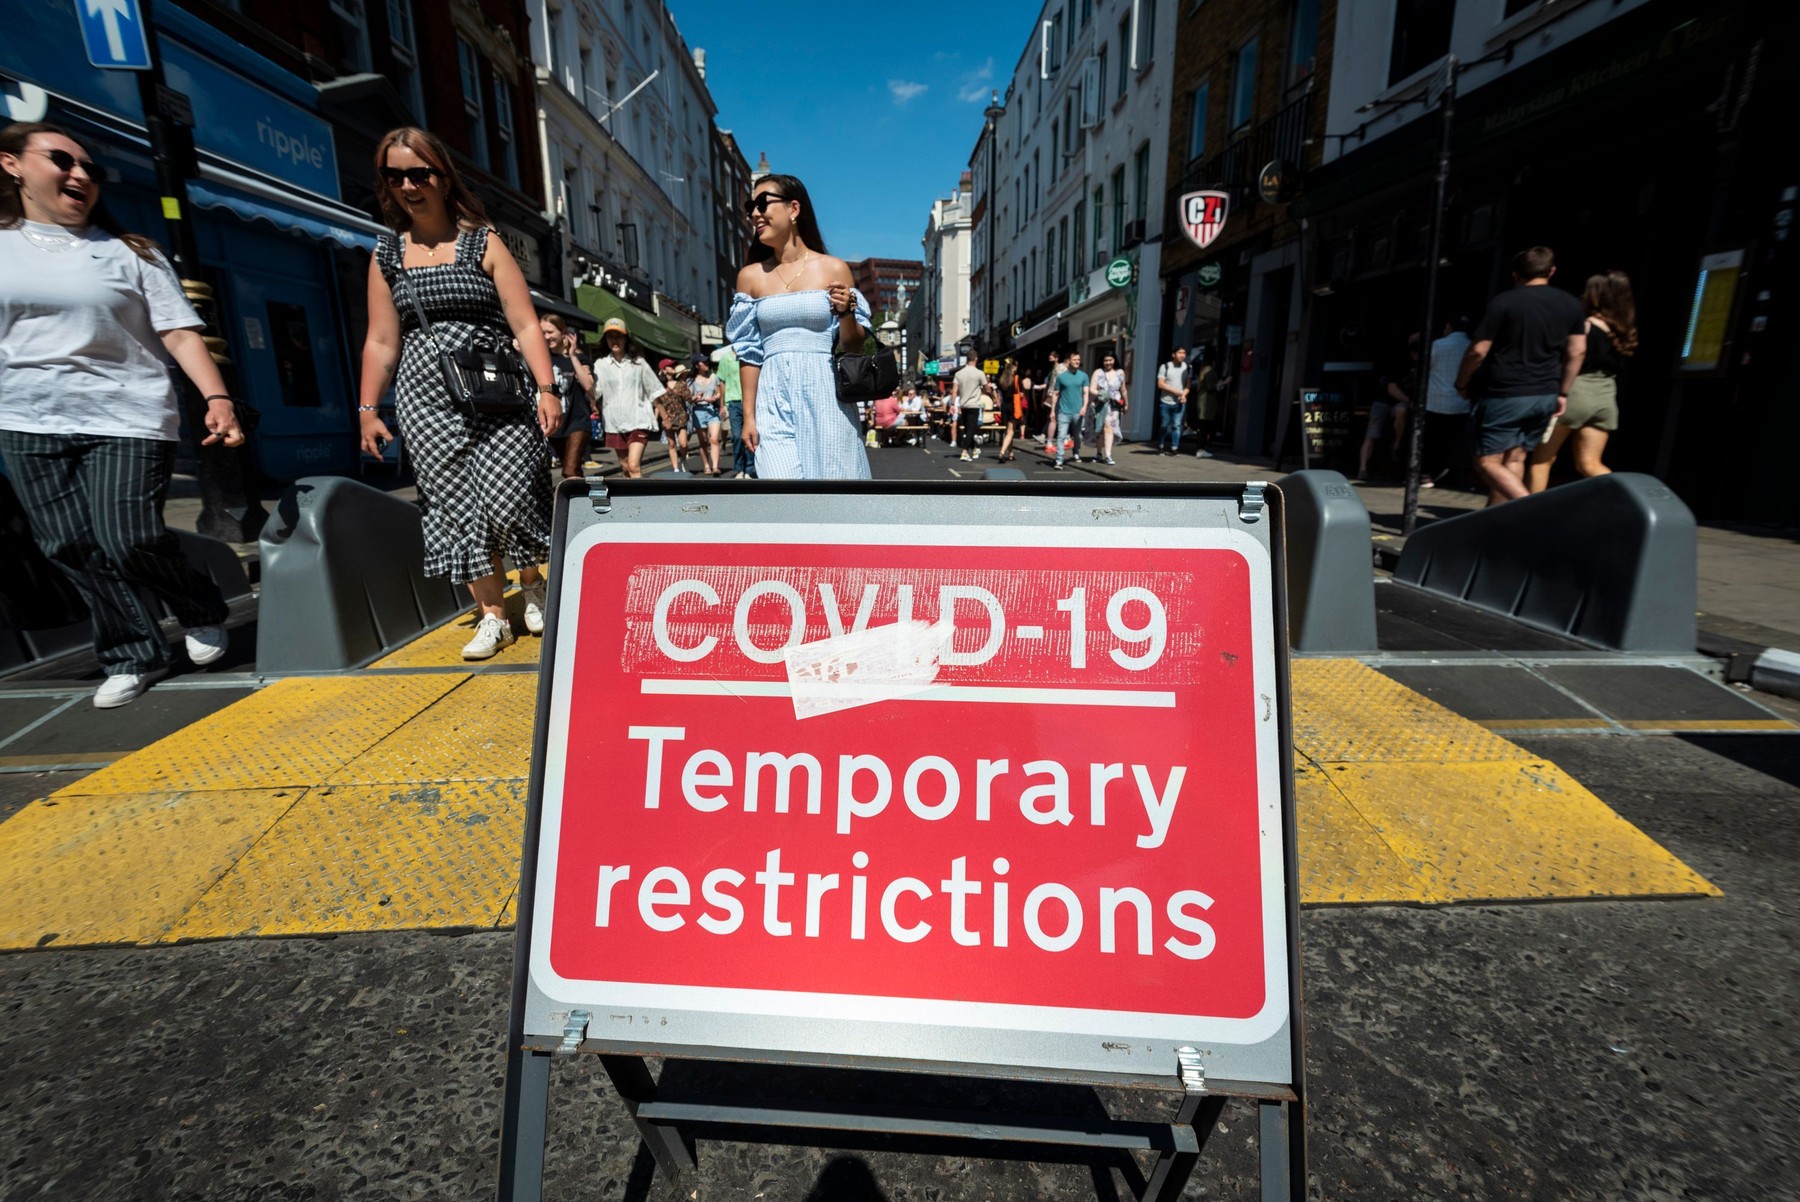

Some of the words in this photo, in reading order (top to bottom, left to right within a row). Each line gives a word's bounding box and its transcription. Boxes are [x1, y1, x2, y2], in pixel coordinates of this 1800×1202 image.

[1568, 51, 1650, 97] Kitchen
[256, 114, 323, 170] ripple
[628, 726, 1187, 848] Temporary
[595, 848, 1217, 960] restrictions
